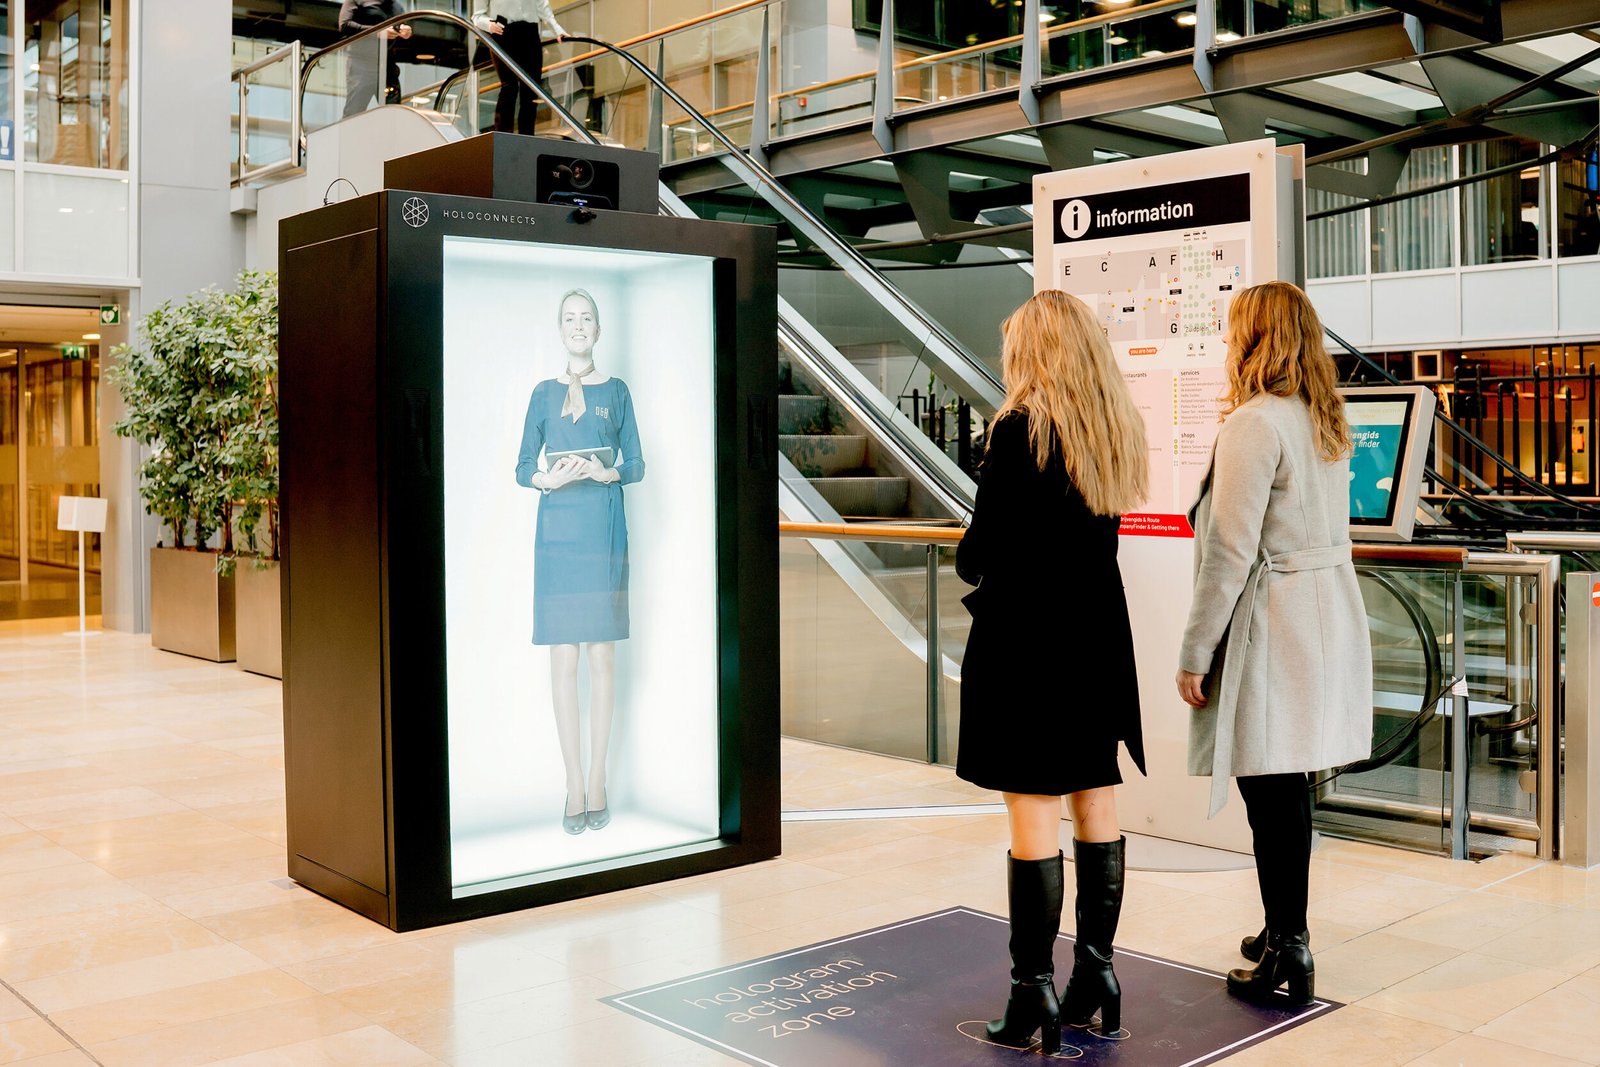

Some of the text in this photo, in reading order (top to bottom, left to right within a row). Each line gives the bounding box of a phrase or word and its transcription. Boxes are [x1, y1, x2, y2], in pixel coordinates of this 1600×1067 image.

[443, 209, 536, 225] HOLOCONNECTS
[1096, 201, 1194, 228] information
[1170, 254, 1177, 266] F
[1215, 249, 1223, 261] H
[1101, 262, 1108, 272] C
[1149, 256, 1156, 267] A
[1064, 265, 1071, 276] E
[1170, 323, 1178, 334] G
[1358, 440, 1380, 448] finder
[682, 956, 864, 1010] hologram
[724, 967, 898, 1024] activation
[758, 1004, 856, 1039] zone
